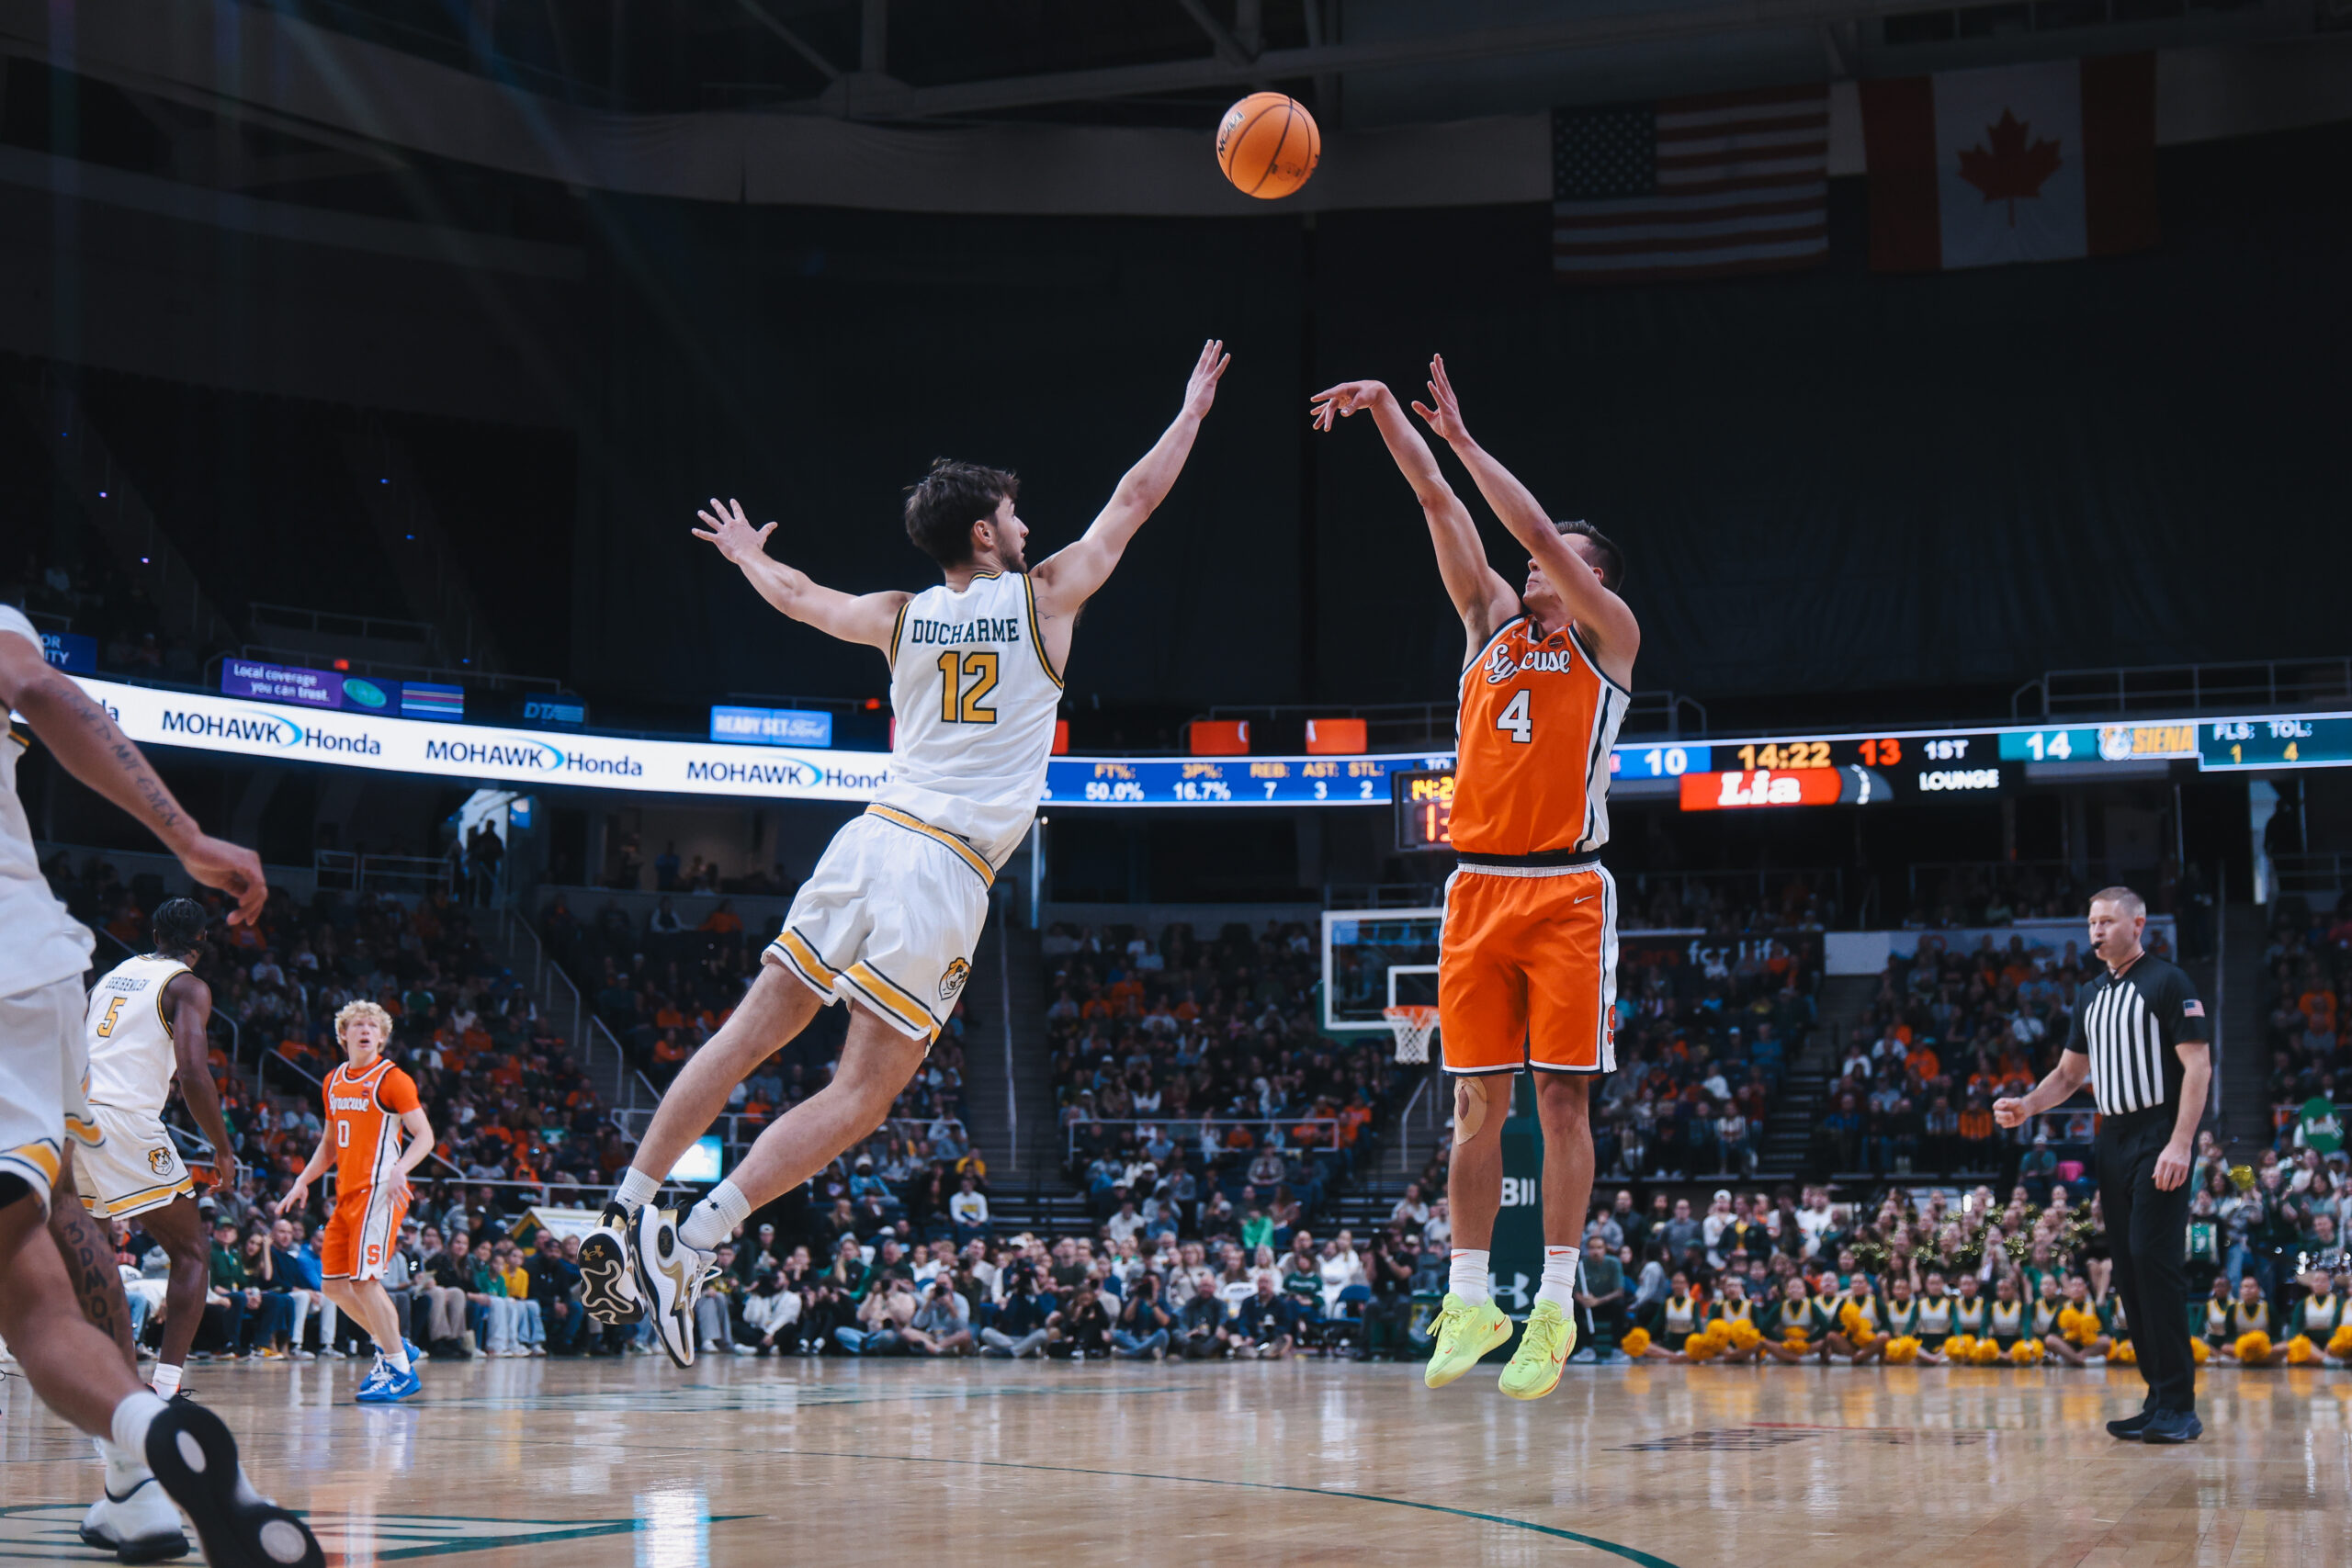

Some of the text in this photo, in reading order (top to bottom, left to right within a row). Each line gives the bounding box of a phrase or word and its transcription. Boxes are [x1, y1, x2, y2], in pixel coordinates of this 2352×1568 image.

[911, 618, 1020, 645] DUCHARME
[233, 663, 317, 687] Local coverage
[1484, 644, 1570, 683] Sycuse
[251, 681, 330, 703] you can trust.
[937, 650, 999, 724] 12
[715, 716, 827, 739] READY SET Ford
[1497, 689, 1532, 744] 4
[2212, 720, 2312, 740] FLS: TOL:
[162, 710, 381, 755] MOHAWK Honda
[2132, 726, 2194, 753] SIENA
[425, 740, 643, 776] MOHAWK Honda
[1737, 741, 1832, 772] 14:22
[1859, 739, 1902, 766] 13
[1924, 739, 1969, 761] 1ST
[2026, 732, 2072, 761] 14
[2230, 741, 2299, 764] 1 4
[686, 761, 896, 789] MOHAWK Hond
[1250, 762, 1290, 778] REB:
[1303, 762, 1340, 778] AST:
[1348, 761, 1385, 778] STL:
[1645, 748, 1688, 776] 10
[1085, 780, 1374, 801] 50.0% 16.7% 7 3 2
[1717, 769, 1802, 807] Lia
[1919, 768, 1999, 791] LOUNGE
[96, 996, 128, 1038] 5
[330, 1093, 369, 1116] Syracuse
[337, 1119, 350, 1148] 0
[367, 1245, 381, 1266] S
